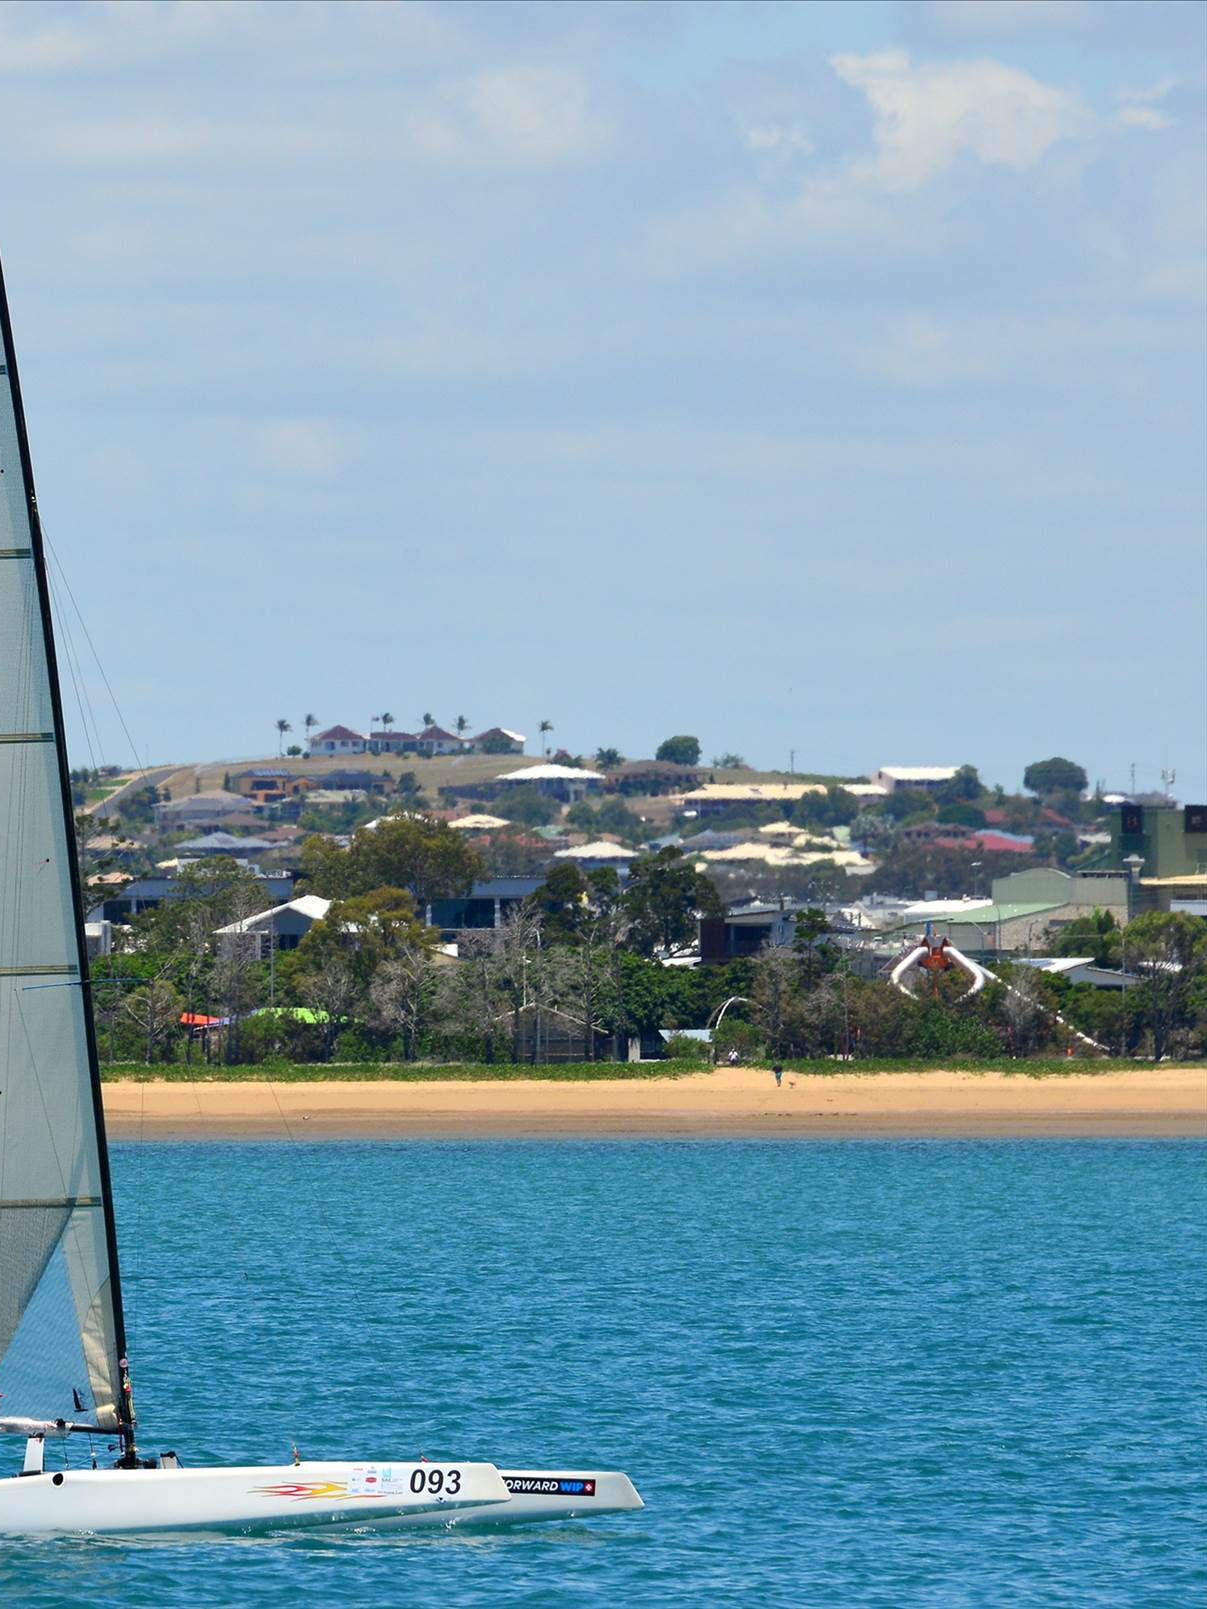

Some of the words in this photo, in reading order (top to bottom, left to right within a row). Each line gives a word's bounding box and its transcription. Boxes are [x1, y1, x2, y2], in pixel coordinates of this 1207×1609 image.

[409, 1469, 461, 1494] 093
[503, 1479, 559, 1491] ORWARD
[560, 1482, 584, 1492] WIP
